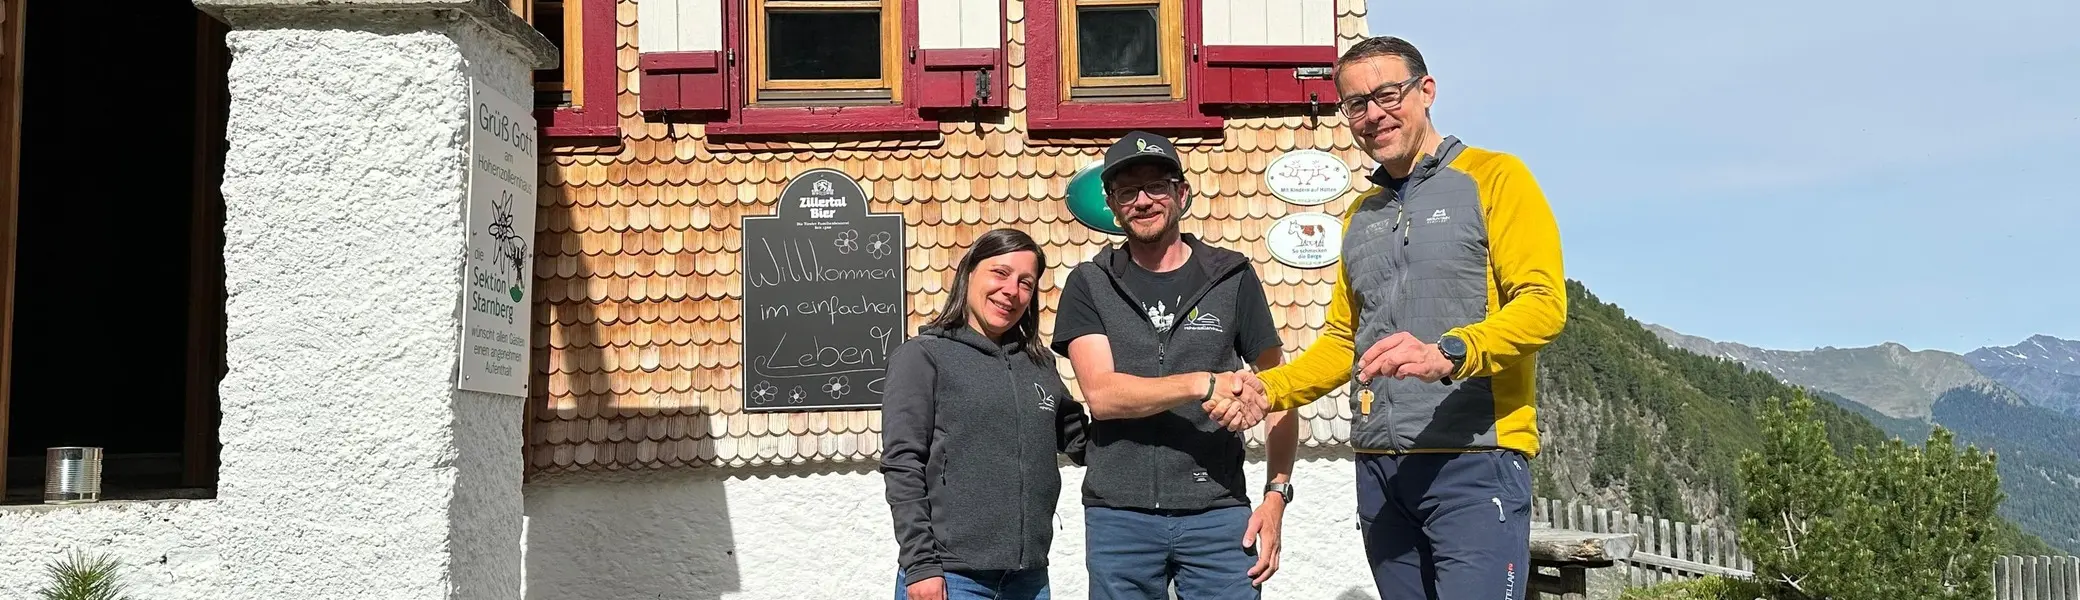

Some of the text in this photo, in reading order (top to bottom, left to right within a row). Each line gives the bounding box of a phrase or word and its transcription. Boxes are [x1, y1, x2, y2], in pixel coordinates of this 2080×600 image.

[479, 103, 533, 158] Grüß Gott
[504, 151, 513, 164] am
[478, 154, 532, 195] Hohenzollernhaus
[799, 196, 847, 208] Zillertal
[810, 208, 836, 218] Bier
[475, 249, 484, 261] die
[747, 237, 896, 288] Willkommen
[473, 266, 506, 295] Sektion
[472, 291, 513, 325] Starnberg
[760, 295, 897, 325] im einfachen
[471, 326, 525, 348] wünscht allen Gästen
[474, 343, 522, 362] einen angenehmen
[485, 361, 512, 377] Aufenthalt
